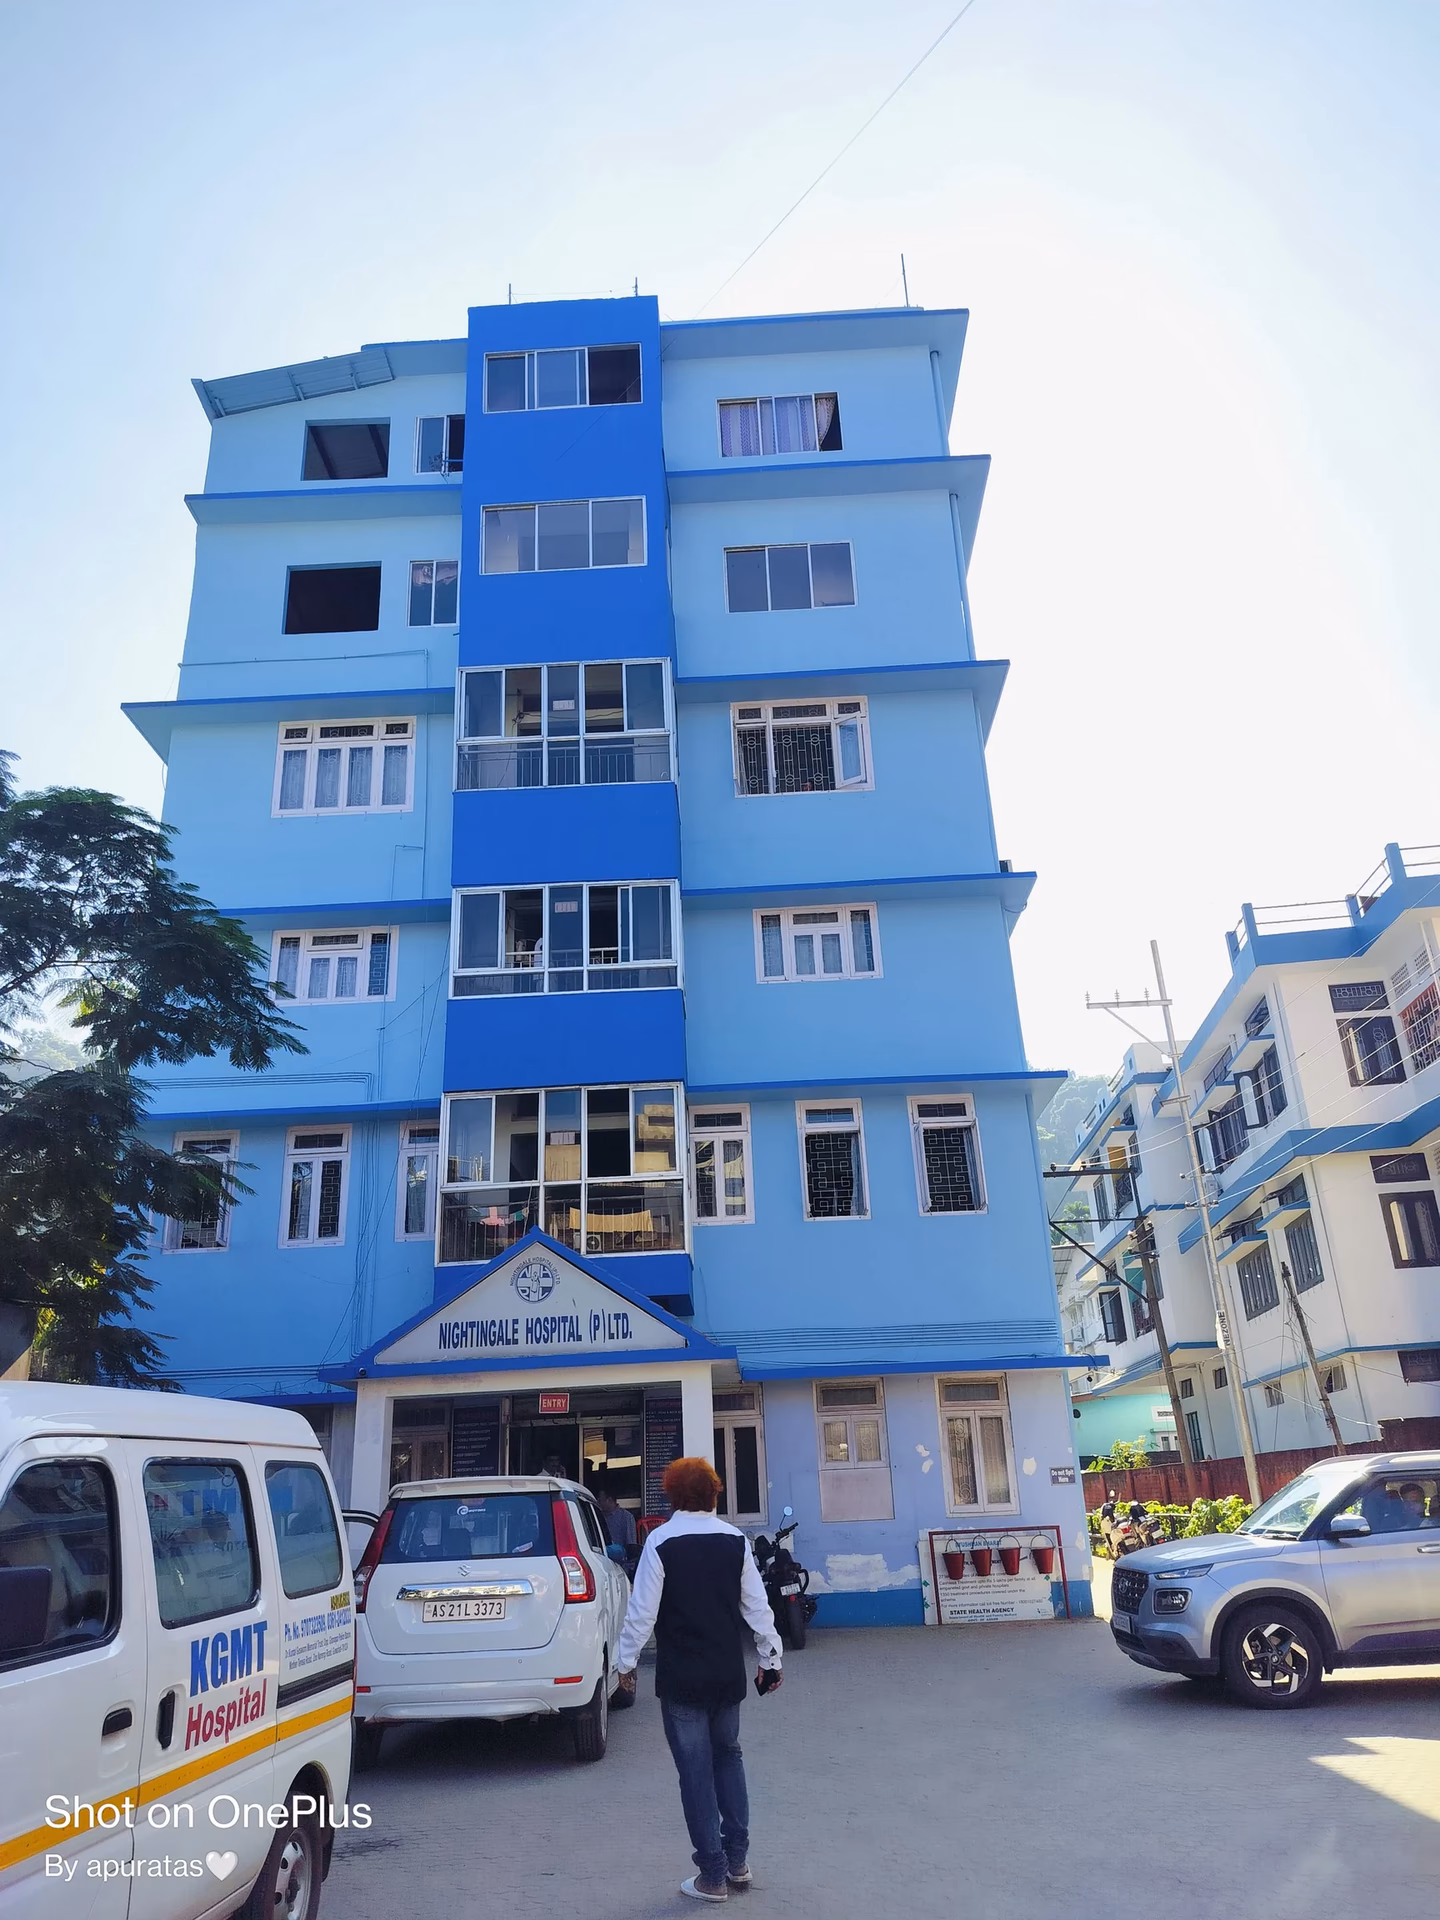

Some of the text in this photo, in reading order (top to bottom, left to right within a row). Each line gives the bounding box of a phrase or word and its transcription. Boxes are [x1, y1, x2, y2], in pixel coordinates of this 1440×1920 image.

[438, 1318, 519, 1350] NIGHTINGALE
[526, 1314, 582, 1345] HOSPITAL
[542, 1398, 566, 1408] ENTRY
[190, 1620, 268, 1698] KGMT
[184, 1678, 267, 1752] Hospital
